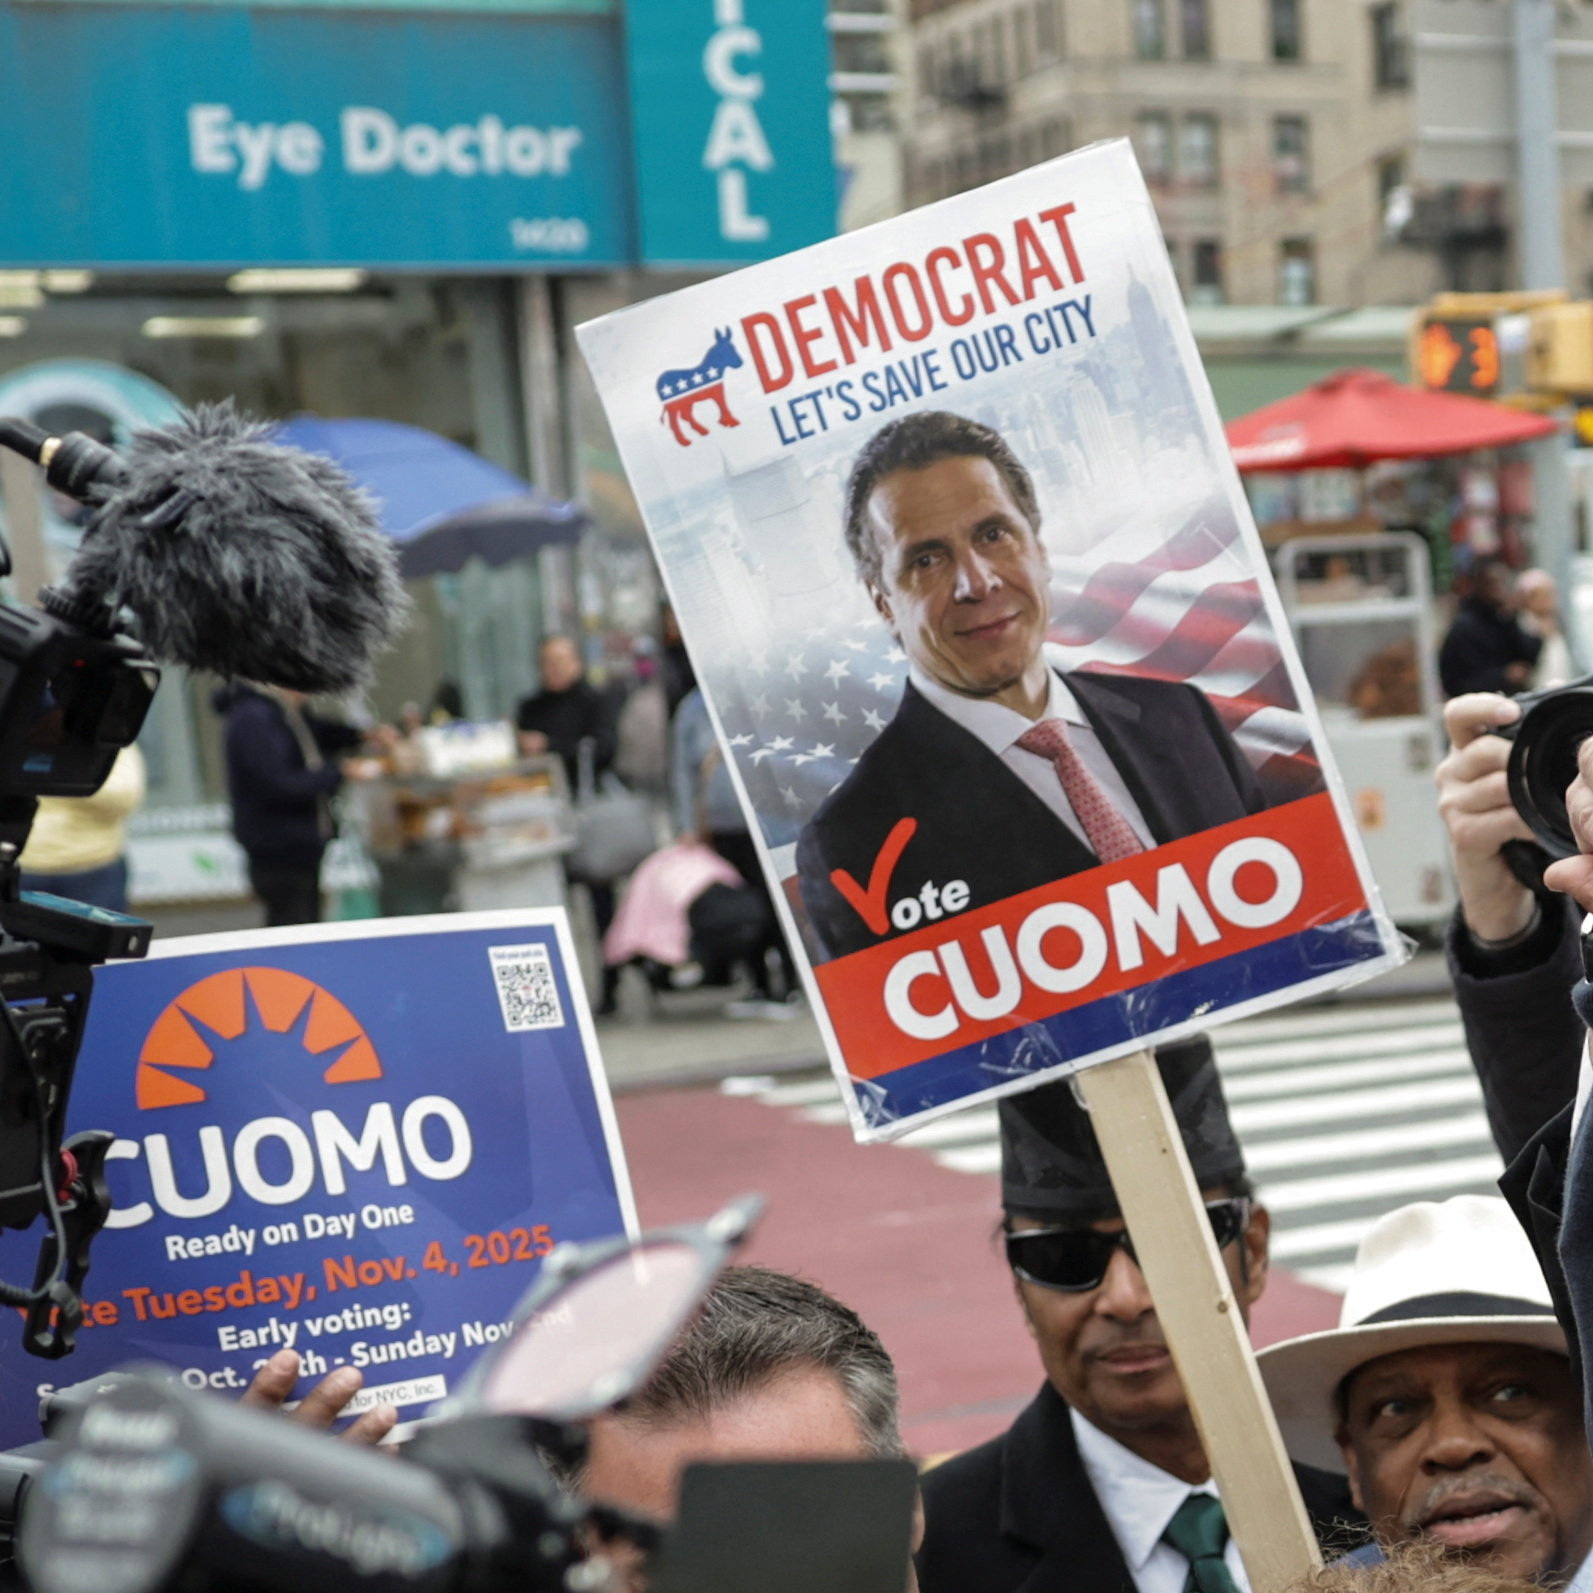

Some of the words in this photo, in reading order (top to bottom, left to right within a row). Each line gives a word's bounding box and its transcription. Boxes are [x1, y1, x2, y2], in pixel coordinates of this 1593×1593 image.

[188, 103, 323, 191] Eye
[341, 105, 584, 177] Doctor
[740, 202, 1086, 395] DEMOCRAT
[770, 379, 862, 446] LET'S
[862, 348, 948, 413] SAVE
[950, 323, 1025, 380] OUR
[1024, 294, 1097, 355] CITY
[883, 836, 1304, 1040] CUOMO
[122, 1270, 316, 1321] Tuesday,
[323, 1255, 417, 1292] Nov.
[422, 1241, 460, 1277] 4,
[464, 1224, 554, 1269] 2025
[165, 1225, 255, 1261] Ready
[263, 1222, 299, 1245] on
[303, 1211, 356, 1239] Day
[361, 1204, 414, 1230] One
[180, 1366, 248, 1391] Oct.
[351, 1330, 456, 1368] Sunday
[217, 1317, 298, 1350] Early
[305, 1302, 412, 1338] voting:
[377, 1385, 412, 1404] NYC,
[414, 1381, 438, 1396] Inc.
